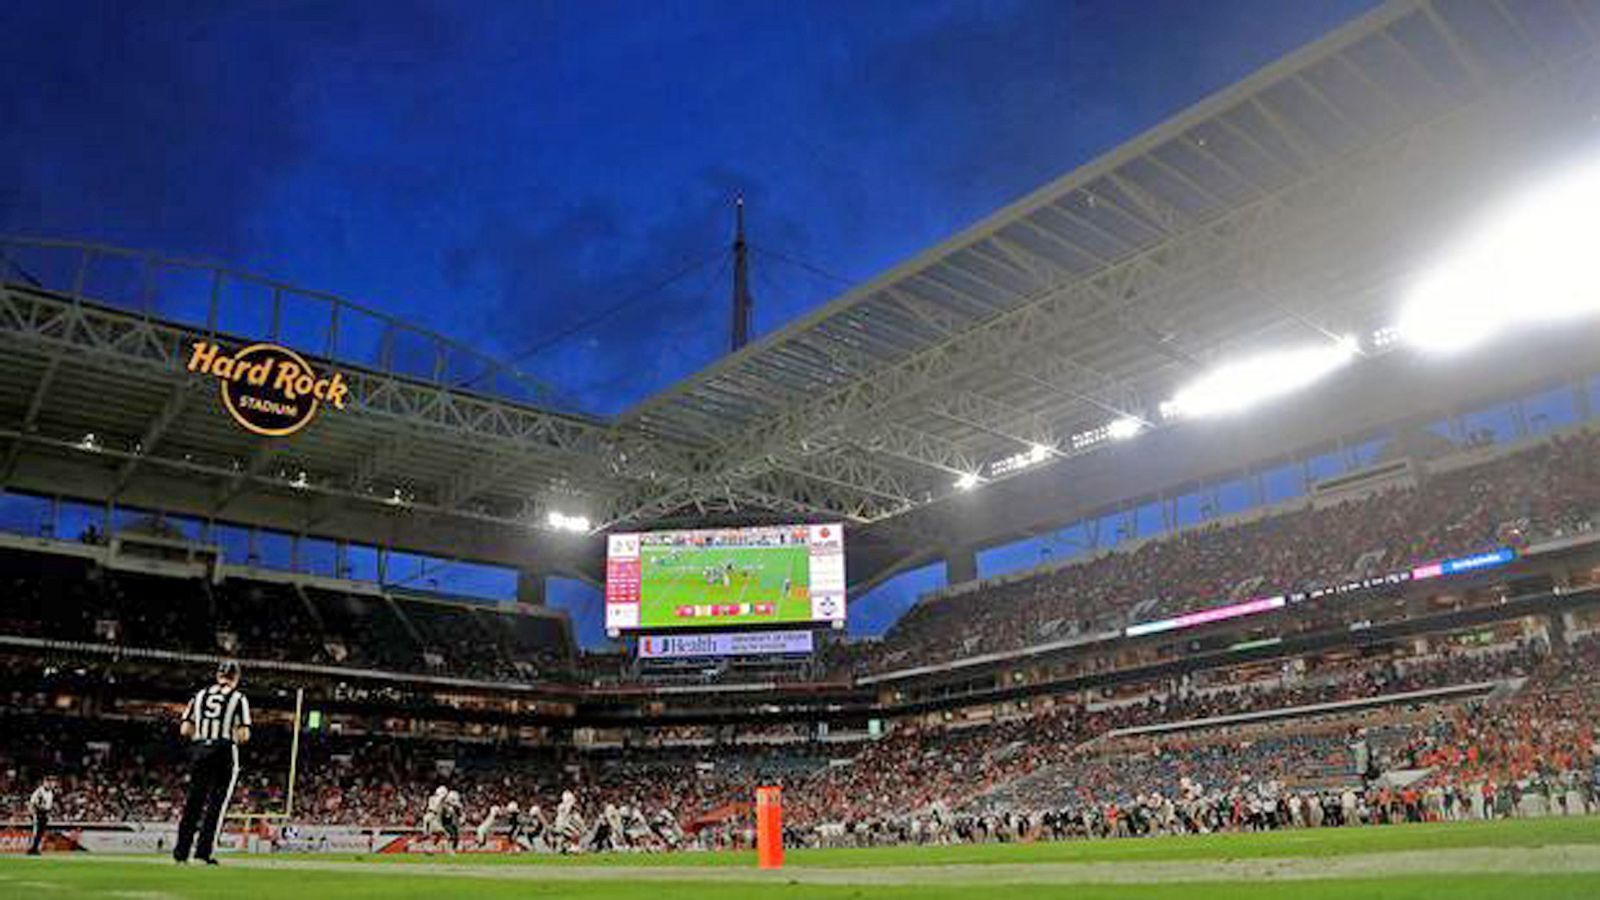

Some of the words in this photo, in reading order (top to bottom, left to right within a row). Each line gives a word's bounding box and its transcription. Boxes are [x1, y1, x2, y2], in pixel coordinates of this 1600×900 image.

[187, 342, 274, 387] Hard
[274, 360, 348, 410] Rock
[239, 395, 298, 417] STADIUM
[203, 694, 225, 718] S
